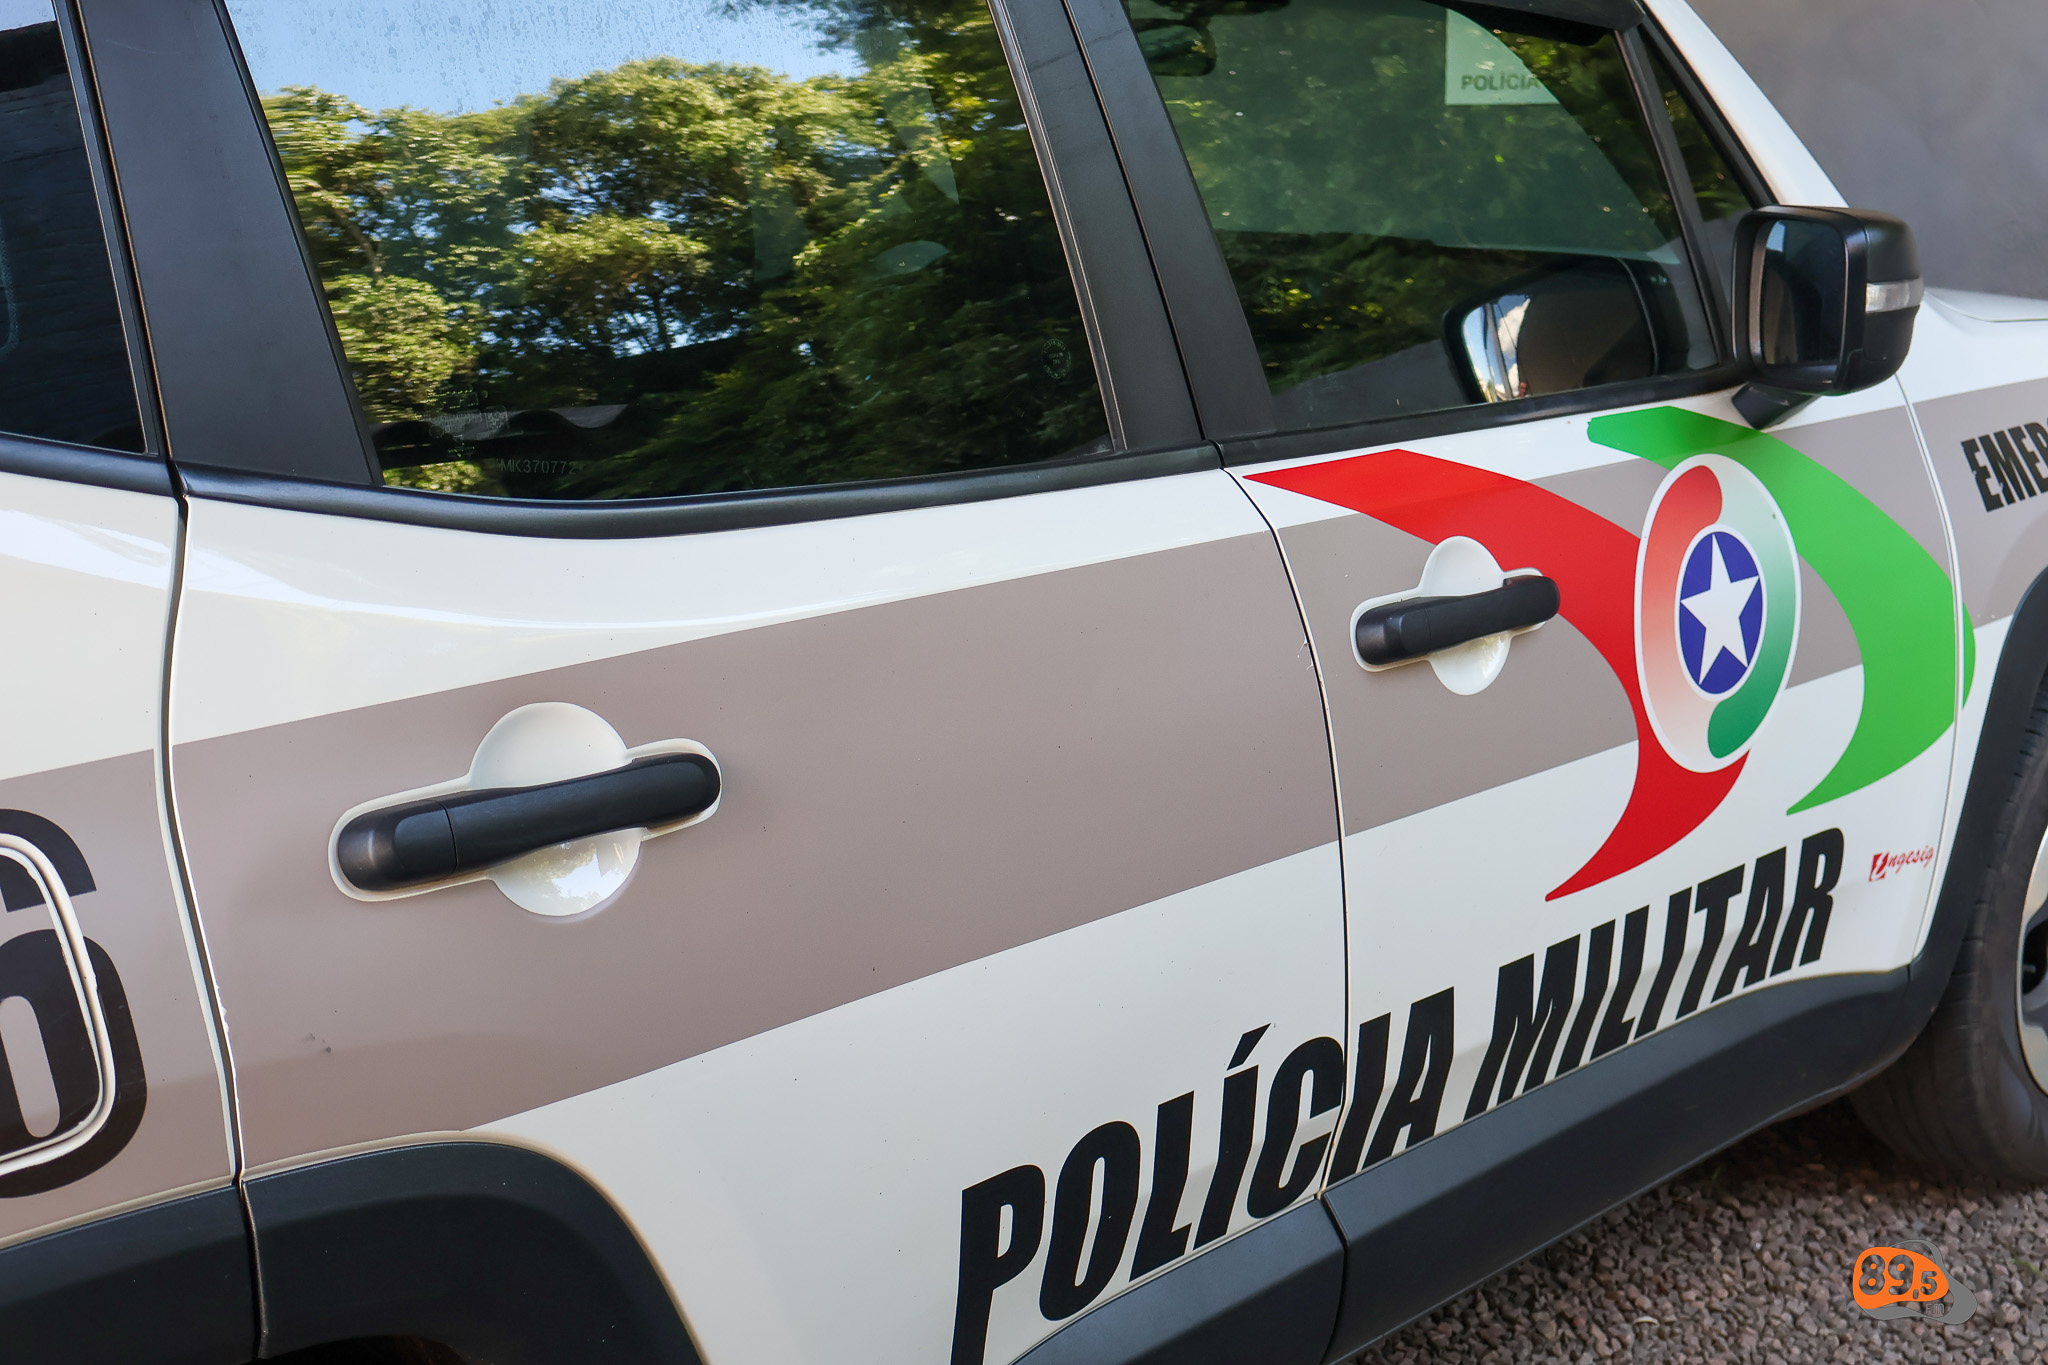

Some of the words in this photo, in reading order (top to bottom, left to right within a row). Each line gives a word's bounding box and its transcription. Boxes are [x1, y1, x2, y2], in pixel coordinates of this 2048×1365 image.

[1461, 72, 1541, 91] POLÍCIA
[950, 986, 1455, 1365] POLÍCIA
[1463, 827, 1844, 1121] MILITAR
